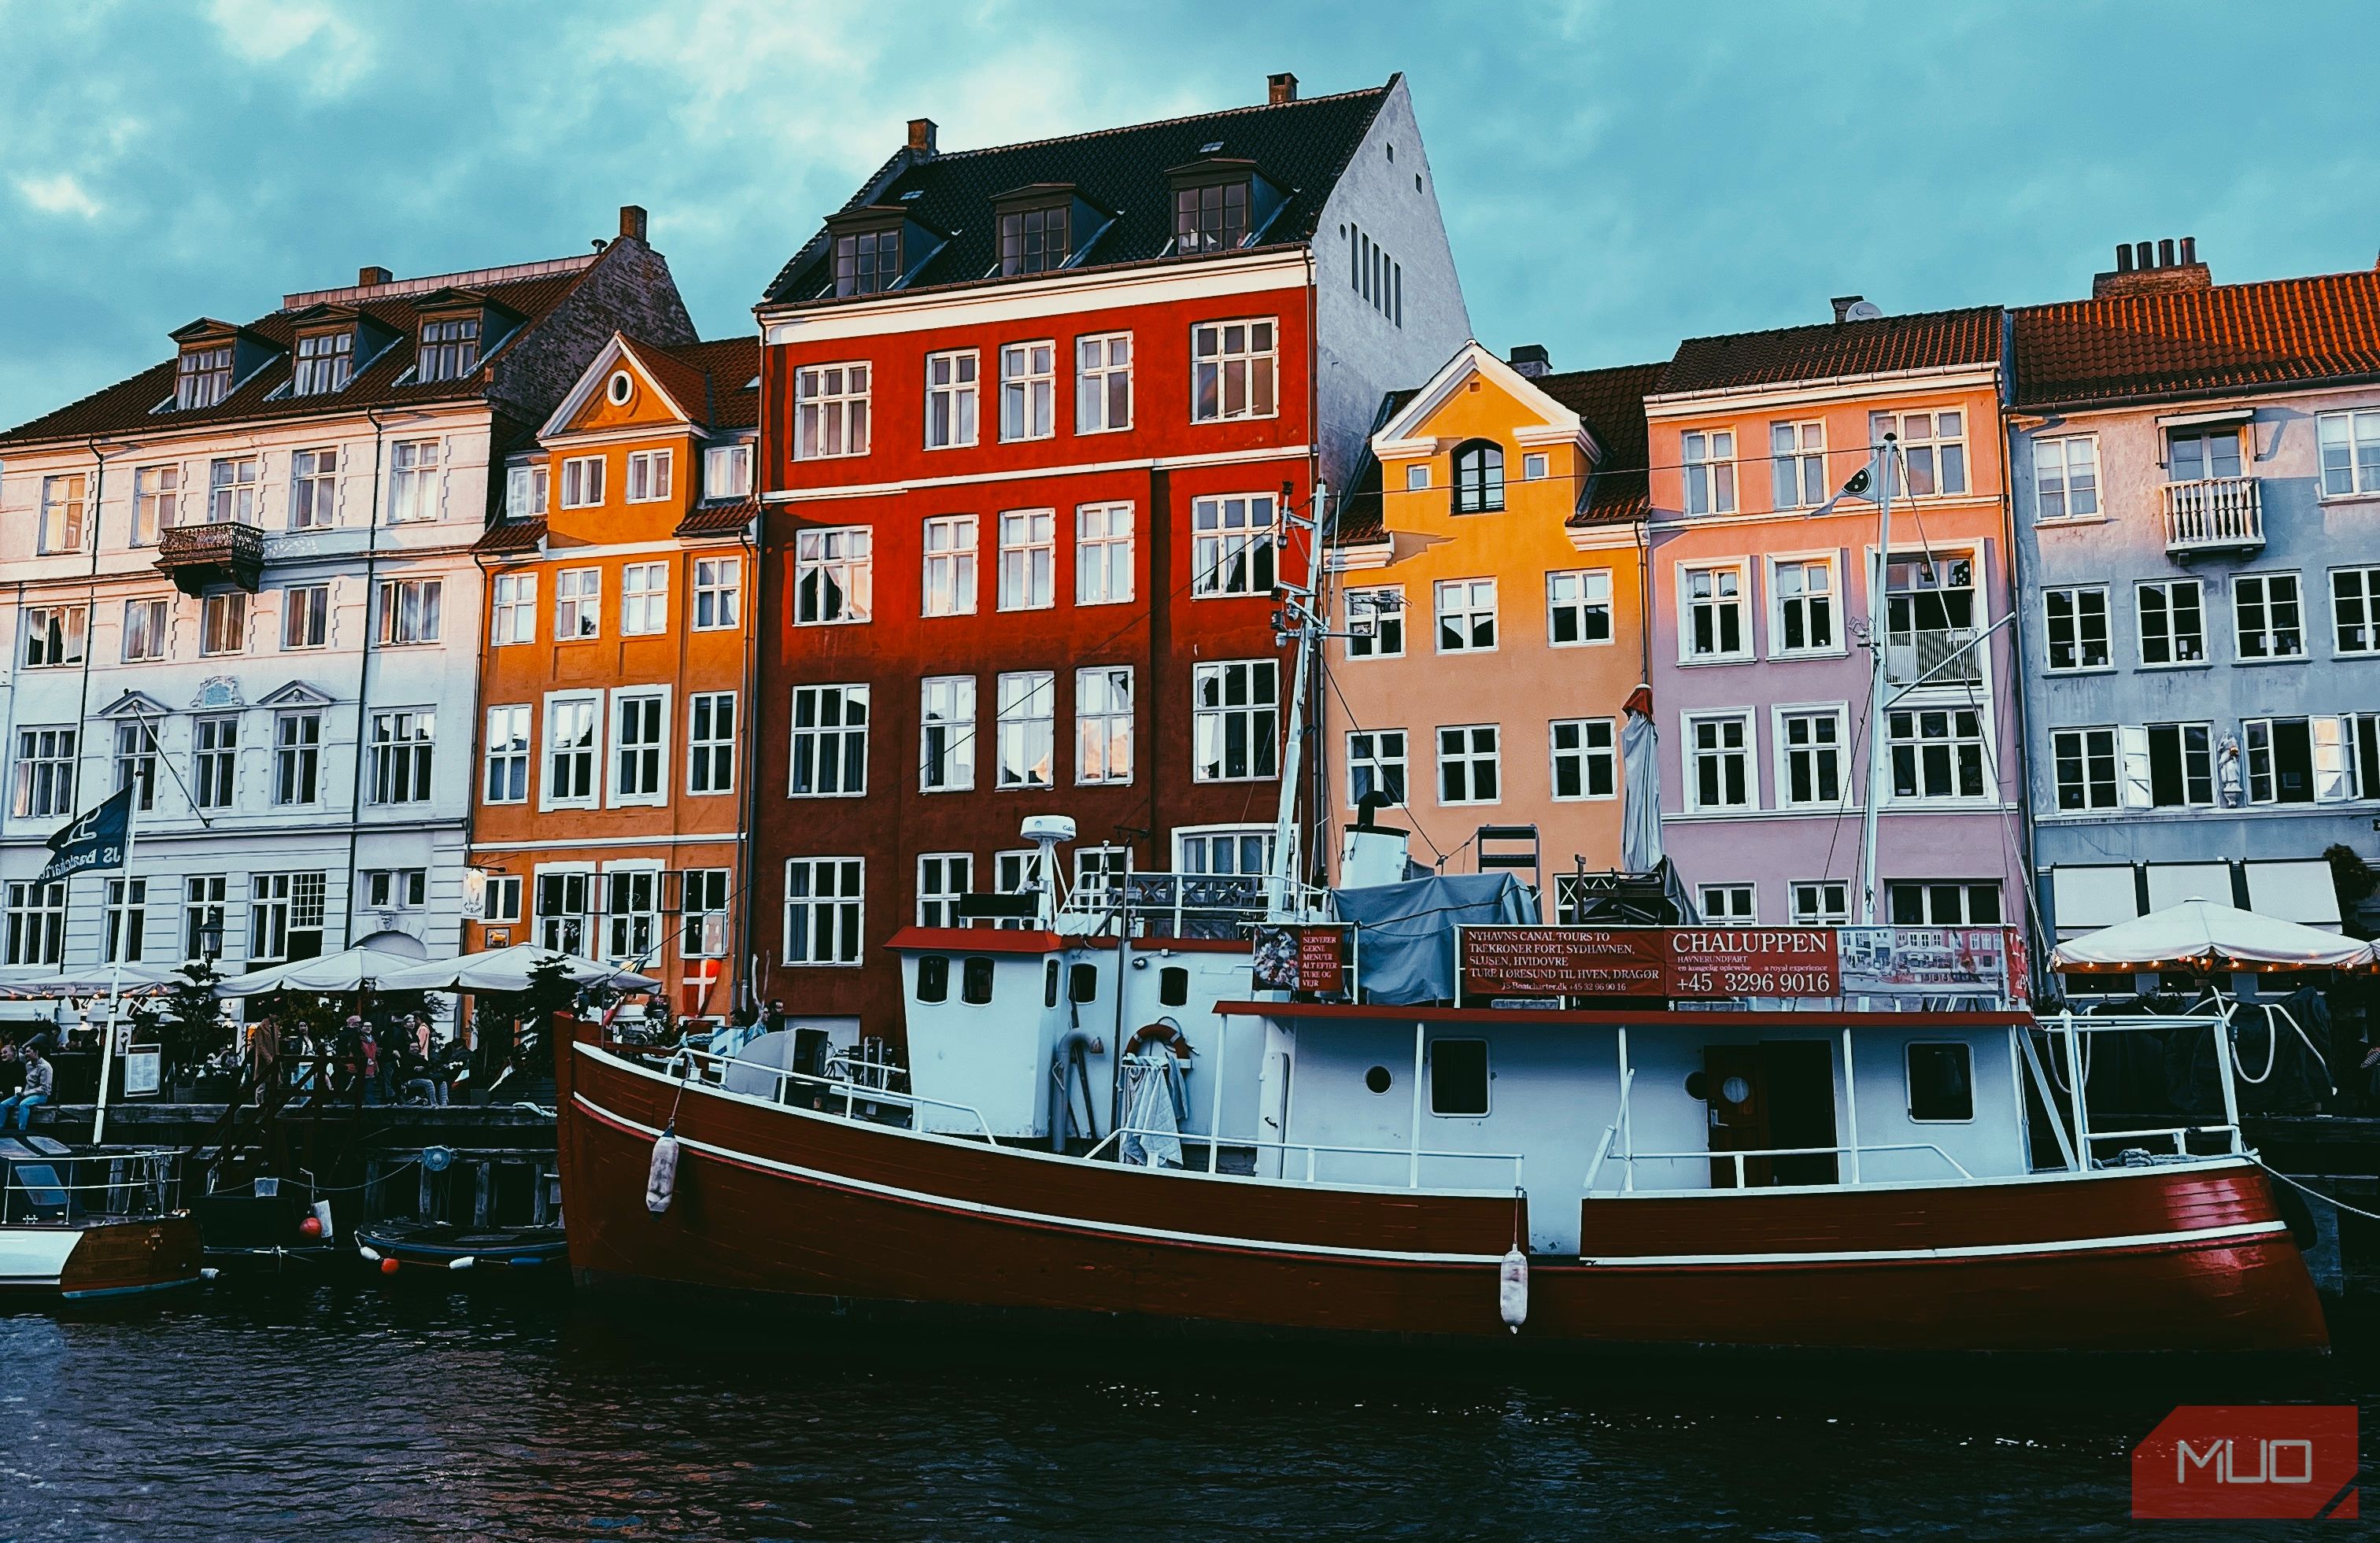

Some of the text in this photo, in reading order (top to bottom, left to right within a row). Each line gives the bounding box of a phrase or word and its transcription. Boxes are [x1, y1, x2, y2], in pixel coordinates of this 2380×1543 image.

[1469, 932, 1609, 941] NYHAVNS CANAL TOURS TO
[1672, 932, 1828, 953] CHALUPPEN
[1469, 943, 1635, 954] TREKRONER FORT, SYDHAVNEN,
[1469, 956, 1569, 967] SLUSEN, HVIDOVRE
[1499, 969, 1503, 977] I
[1506, 969, 1556, 978] ØRESUND
[1558, 969, 1576, 978] TIL
[1578, 969, 1611, 980] HVEN,
[1613, 969, 1659, 980] DRAGØR
[1595, 983, 1604, 991] 96
[1606, 983, 1616, 991] 90
[1617, 983, 1626, 991] 16
[1676, 973, 1830, 992] +45 3296 9016
